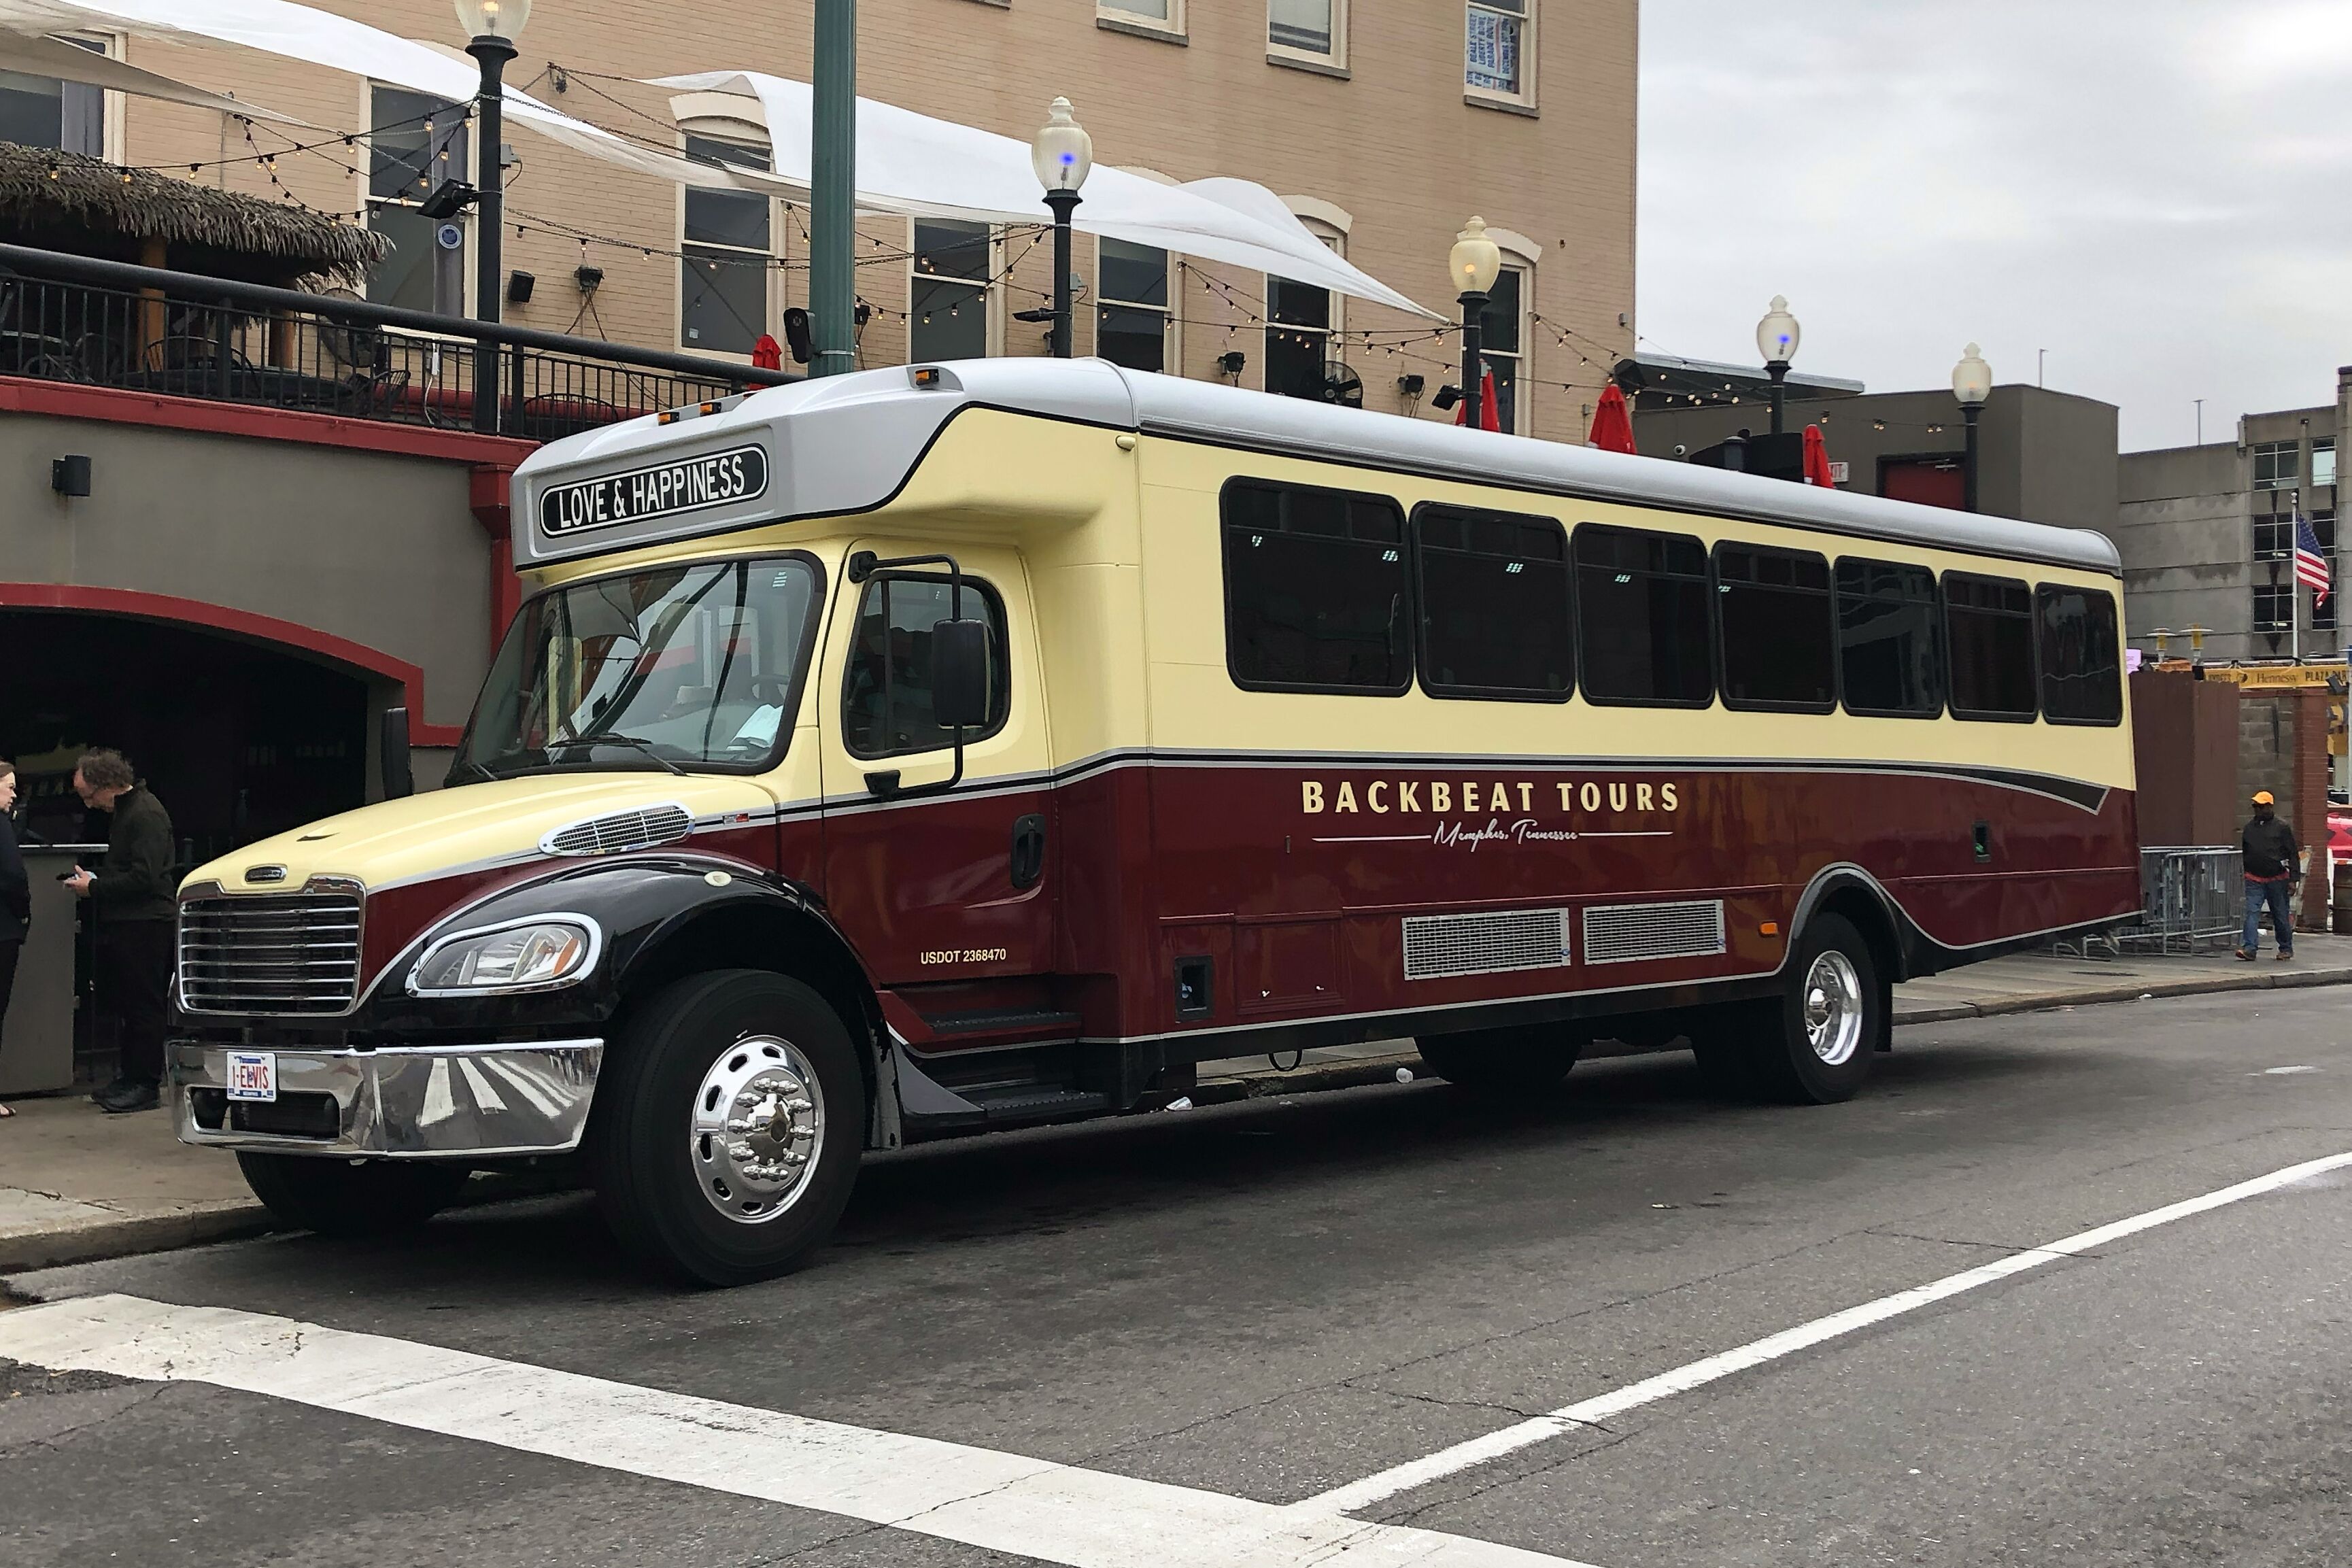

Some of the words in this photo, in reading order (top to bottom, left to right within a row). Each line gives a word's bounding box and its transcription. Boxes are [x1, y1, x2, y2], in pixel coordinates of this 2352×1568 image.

[559, 483, 607, 528] LOVE
[614, 480, 626, 518] &
[632, 455, 745, 514] HAPPINESS
[1302, 781, 1534, 813] BACKBEAT
[1556, 782, 1678, 812] TOURS
[1433, 818, 1509, 852] Memphis,
[1510, 819, 1578, 845] Tennessee
[921, 950, 961, 964] USDOT
[963, 948, 1006, 962] 2368470
